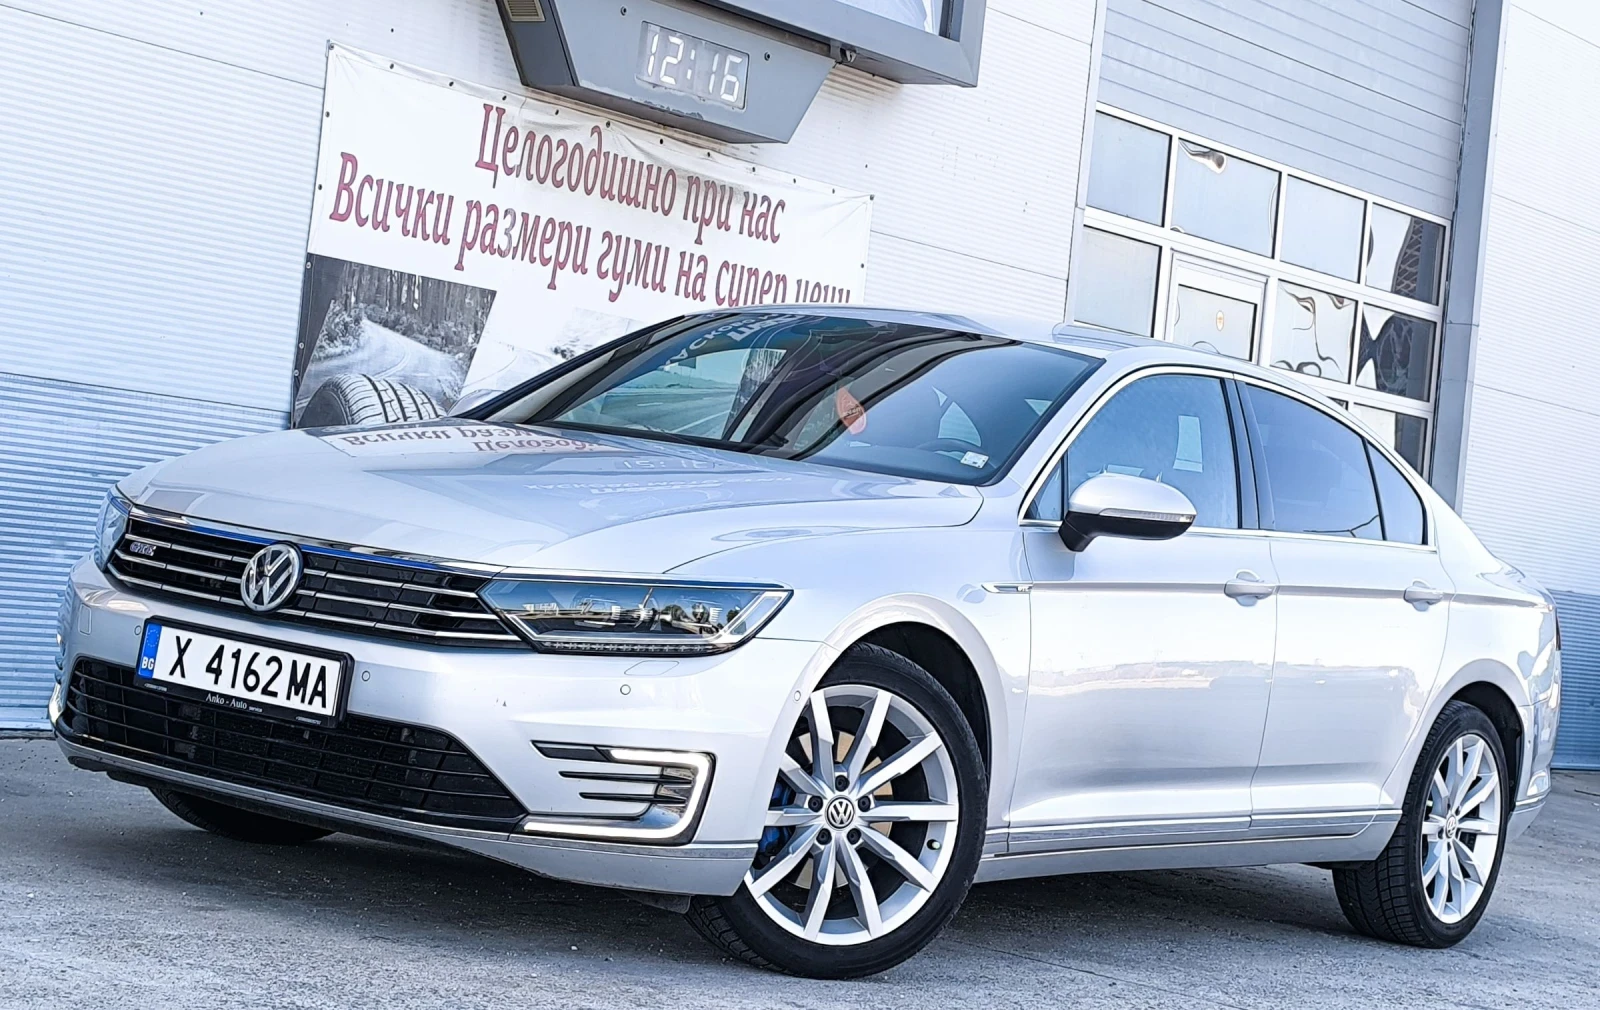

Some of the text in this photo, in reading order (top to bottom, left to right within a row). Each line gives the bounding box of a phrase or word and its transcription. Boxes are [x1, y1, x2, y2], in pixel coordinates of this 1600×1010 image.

[648, 34, 743, 103] 12:16
[475, 102, 786, 246] Целогодишно при нас
[329, 152, 455, 246] Всички
[454, 199, 592, 291] размери
[596, 230, 670, 303] гуми
[674, 250, 709, 303] на
[141, 656, 154, 671] BG
[168, 635, 193, 679] X
[205, 692, 225, 705] Anko
